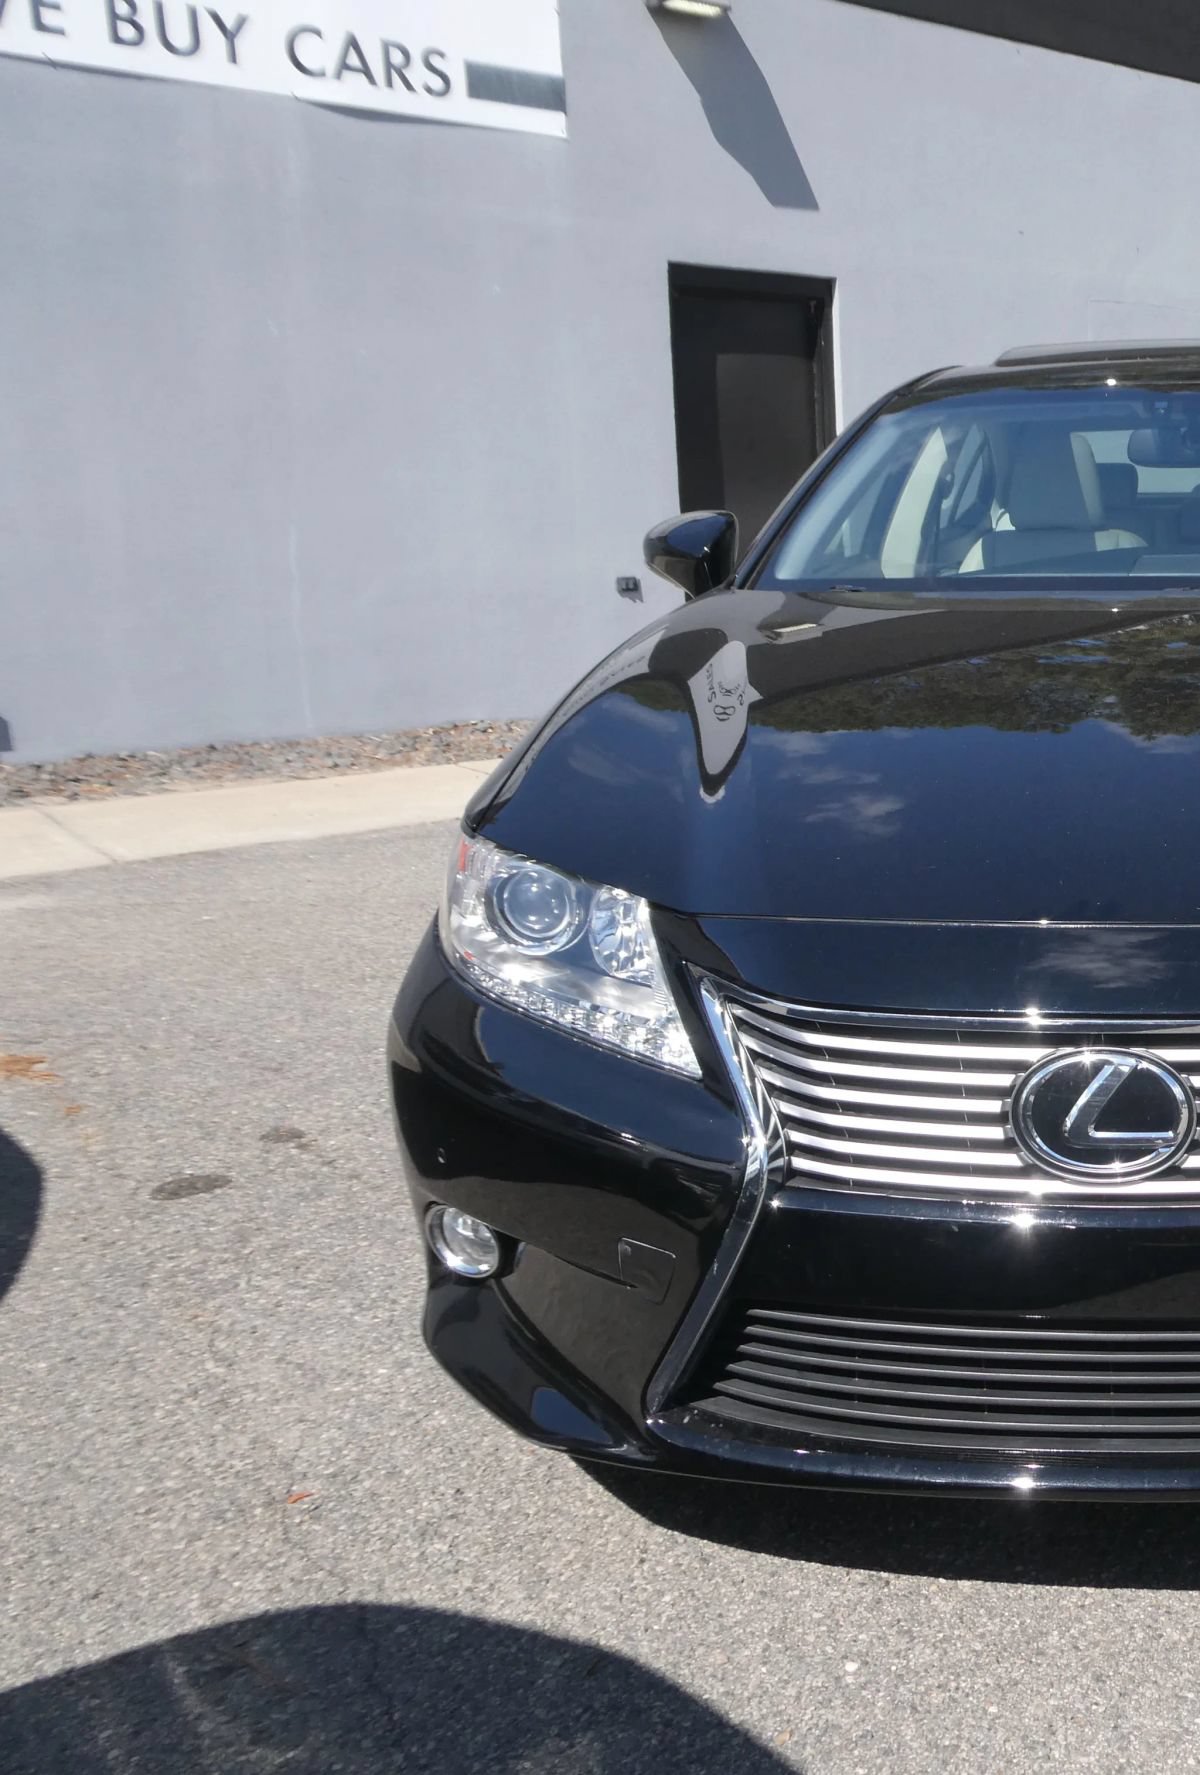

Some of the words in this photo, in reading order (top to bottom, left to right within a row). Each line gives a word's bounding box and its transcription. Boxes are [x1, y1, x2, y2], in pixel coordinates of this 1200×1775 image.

[0, 0, 65, 36] E
[103, 0, 248, 64] BUY
[285, 23, 453, 97] CARS
